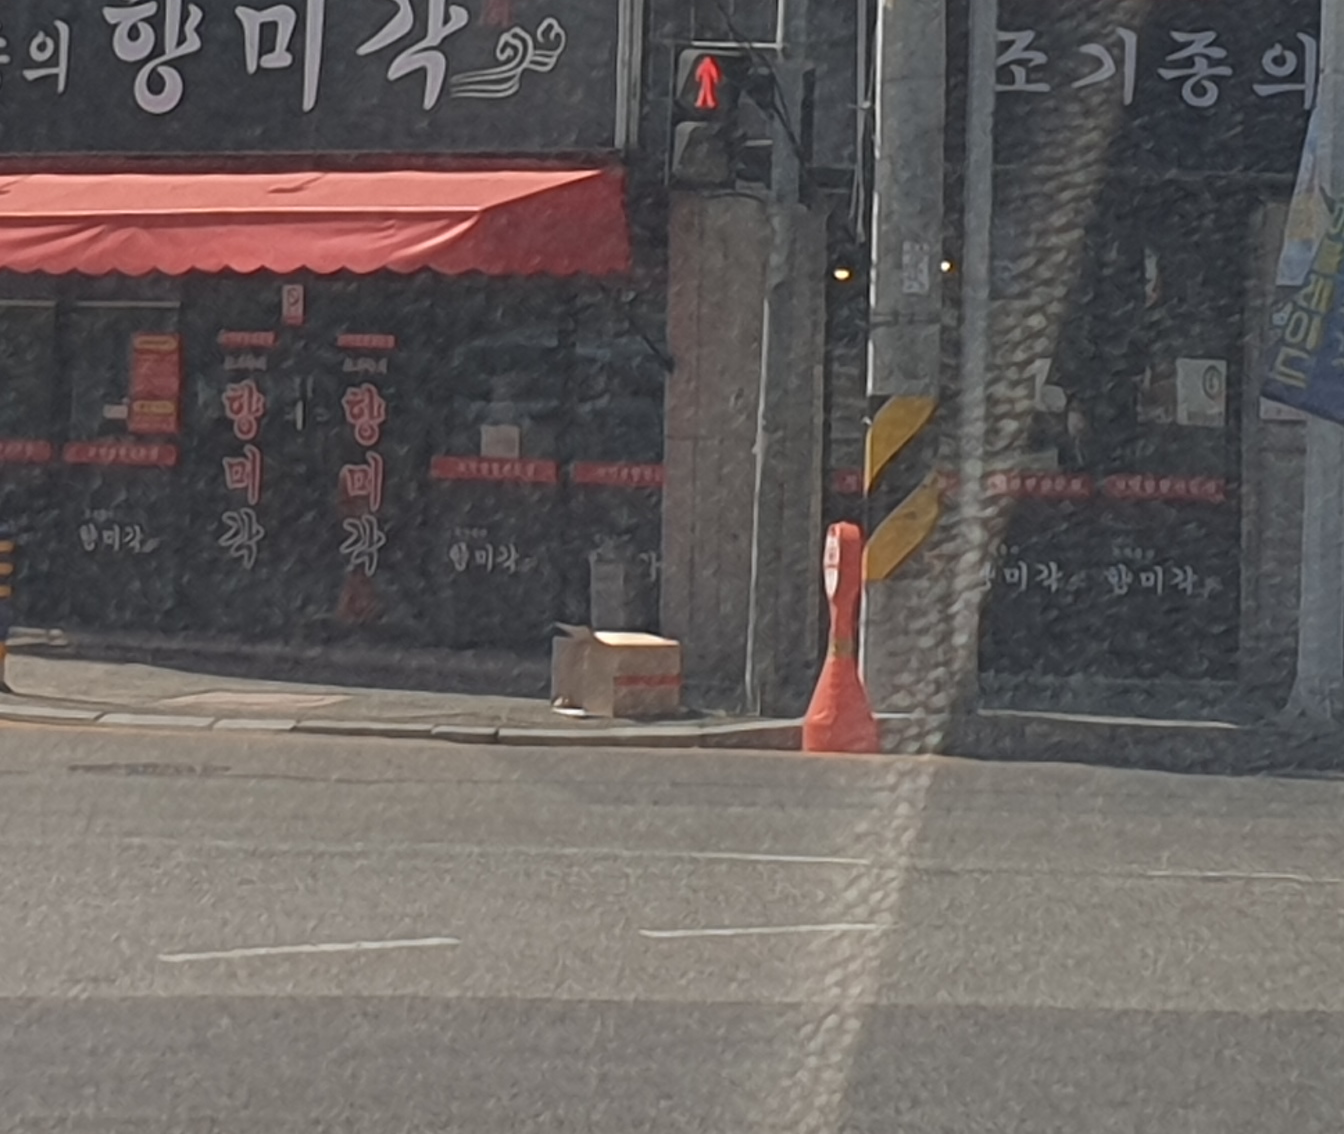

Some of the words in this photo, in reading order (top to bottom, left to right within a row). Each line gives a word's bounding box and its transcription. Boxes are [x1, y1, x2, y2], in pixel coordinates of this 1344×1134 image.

[994, 26, 1319, 110] 조기종의
[218, 378, 266, 570] 향미각
[339, 382, 388, 578] 향미각
